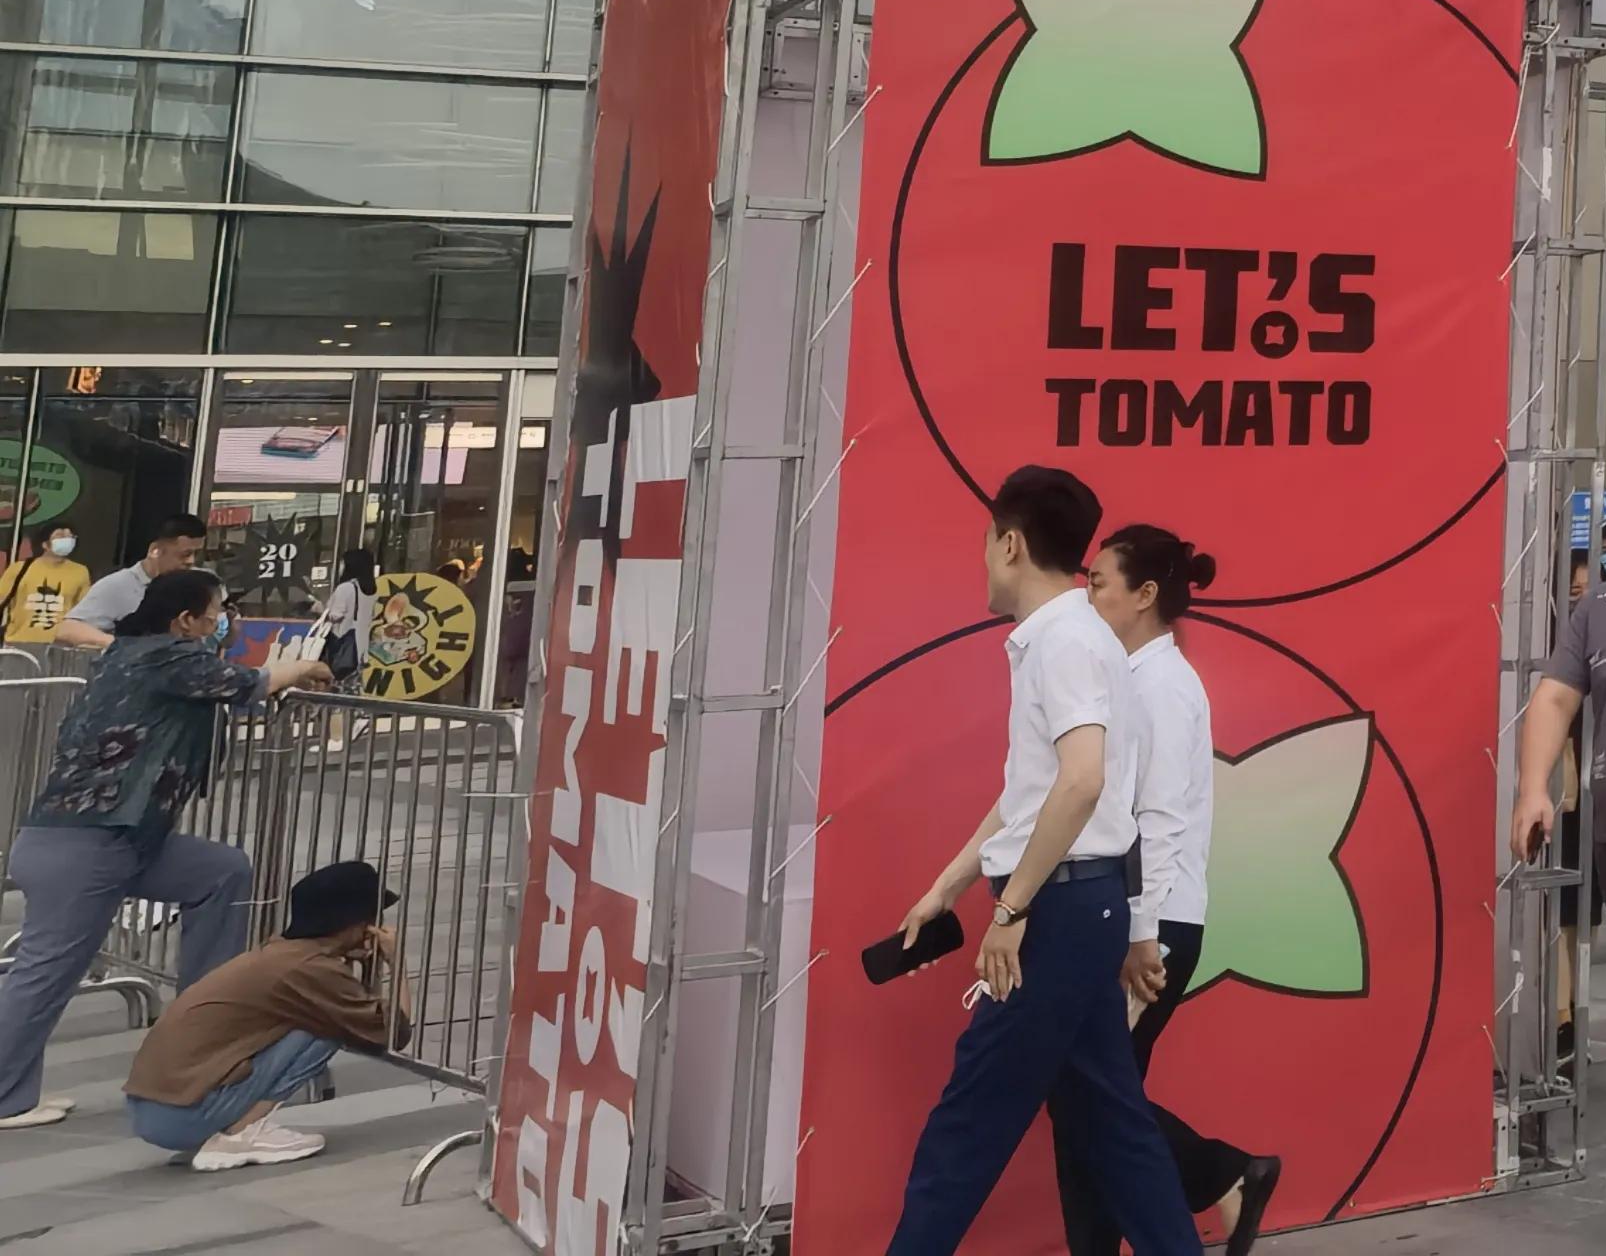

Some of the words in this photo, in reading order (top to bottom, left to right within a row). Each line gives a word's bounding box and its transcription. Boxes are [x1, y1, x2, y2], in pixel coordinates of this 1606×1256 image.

[1045, 378, 1372, 447] TOMATO
[260, 544, 297, 561] 20
[259, 561, 292, 578] 21
